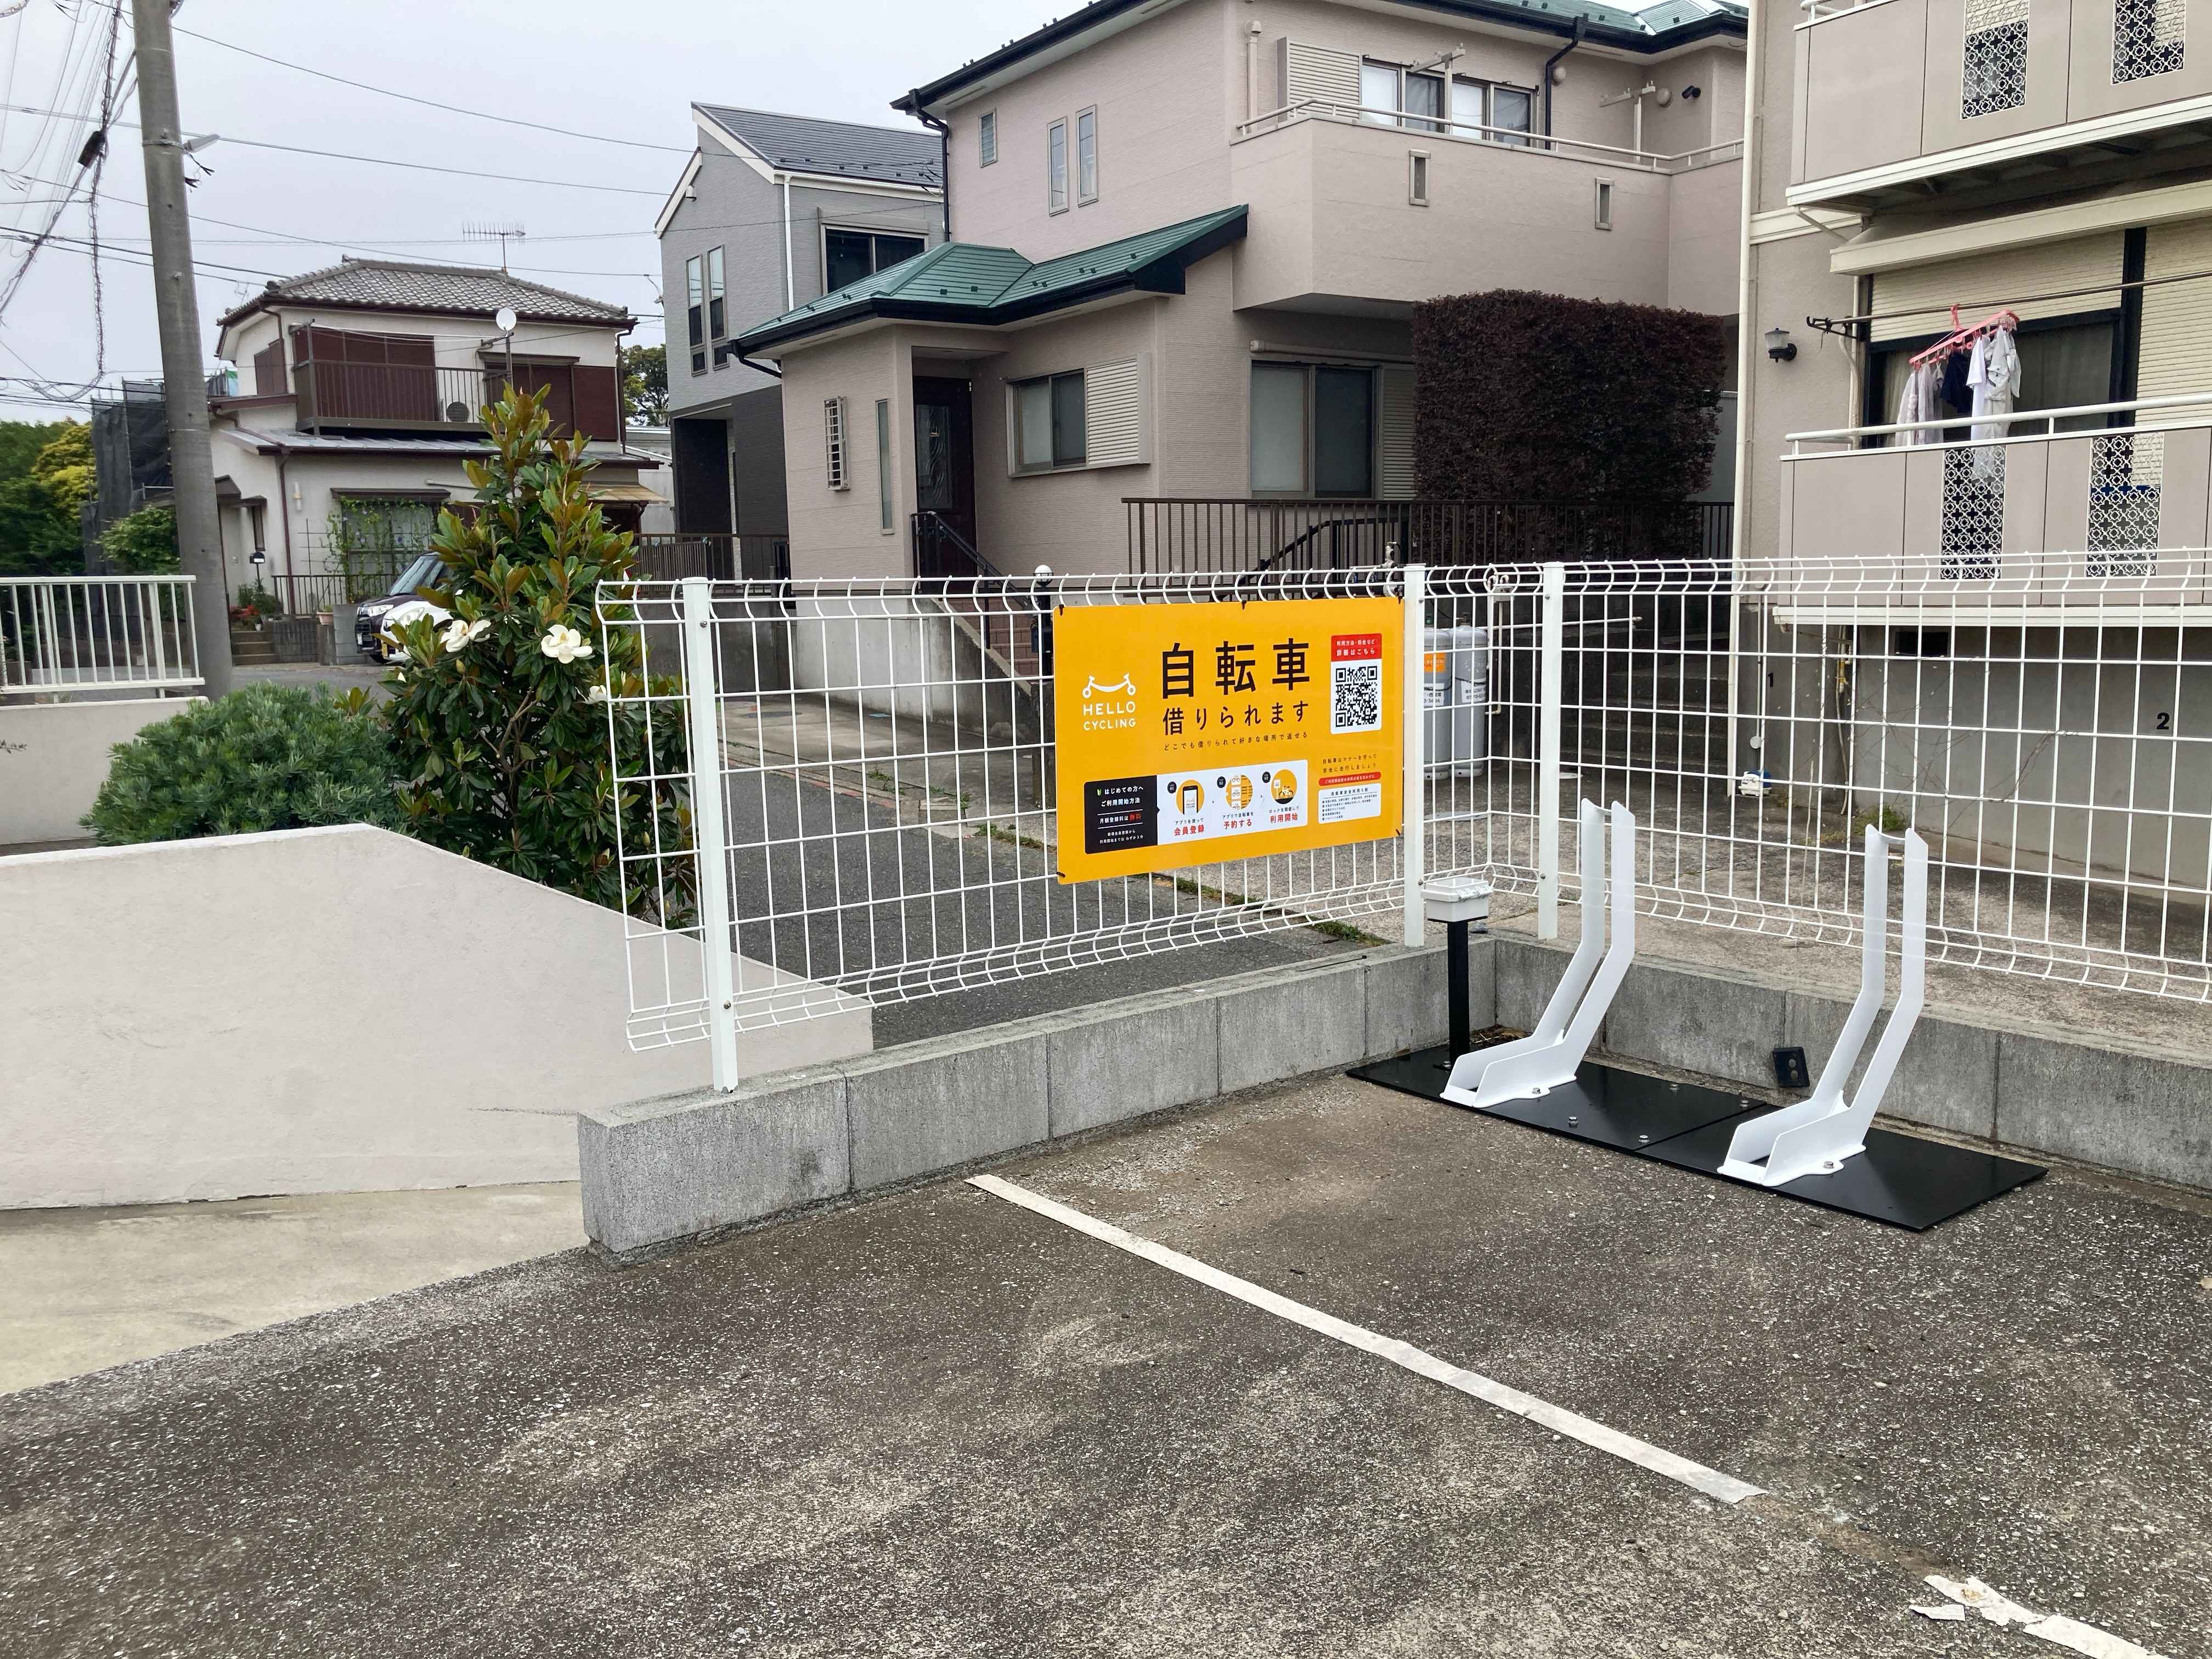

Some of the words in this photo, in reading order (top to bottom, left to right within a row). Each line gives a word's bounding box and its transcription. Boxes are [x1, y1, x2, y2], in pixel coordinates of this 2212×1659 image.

[1336, 648, 1375, 657] 詳細はこちら
[1163, 638, 1310, 699] 自転車
[1083, 701, 1136, 715] HELLO
[1163, 700, 1308, 735] 借りられます
[2157, 713, 2170, 730] 2
[1084, 718, 1136, 731] CYCLING
[1164, 732, 1307, 751] どこでも借りられて好きな場所で返せる
[1104, 786, 1144, 795] はじめての方へ
[1101, 797, 1140, 807] ご利用開始方法
[1270, 812, 1298, 823] 利用開始
[1174, 825, 1204, 836] 会員登録
[1224, 819, 1251, 830] 予約する
